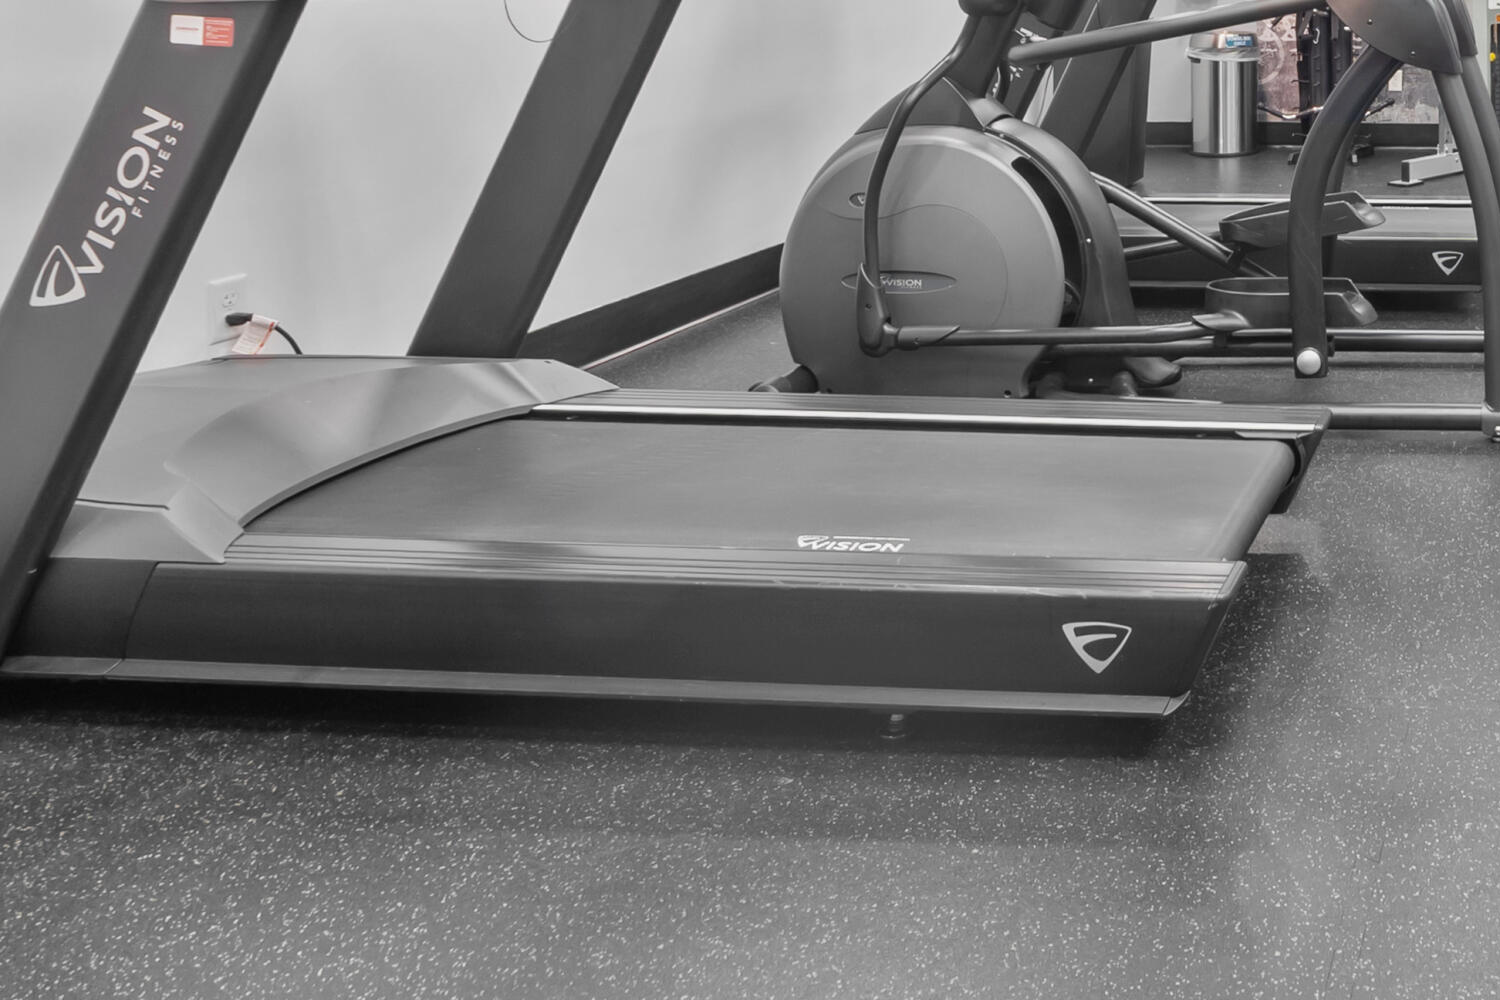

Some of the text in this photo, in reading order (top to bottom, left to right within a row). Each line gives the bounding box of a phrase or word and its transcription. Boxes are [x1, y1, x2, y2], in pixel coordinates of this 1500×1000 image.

[75, 106, 172, 273] VISION
[131, 119, 184, 219] FITNESS
[812, 541, 904, 552] VISION
